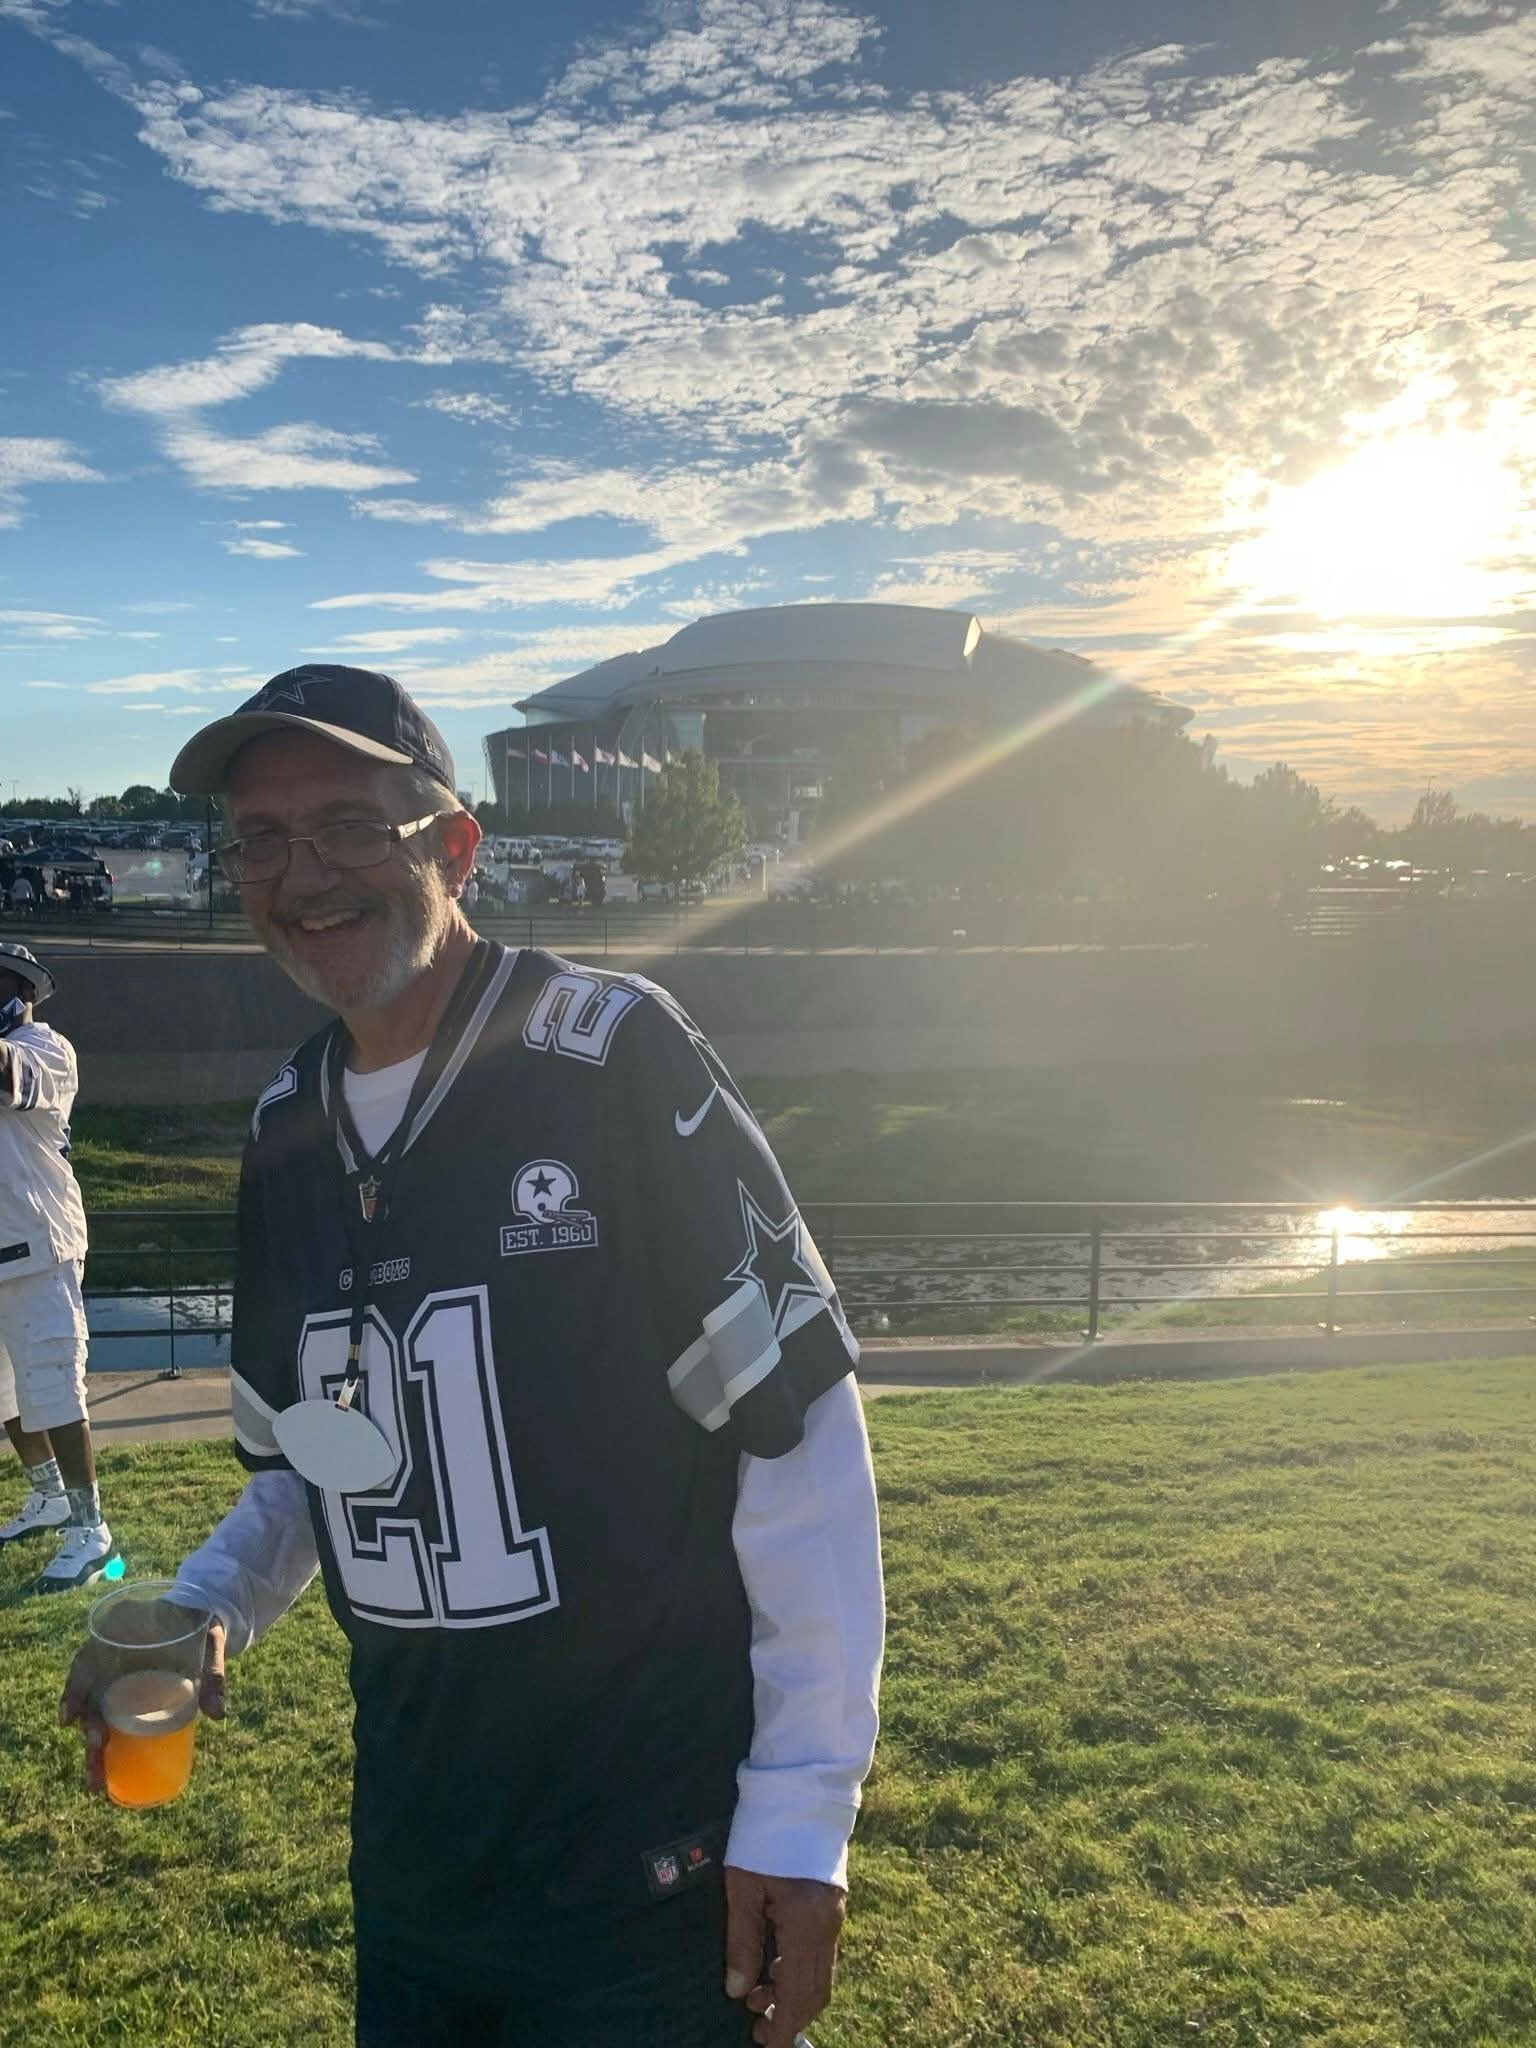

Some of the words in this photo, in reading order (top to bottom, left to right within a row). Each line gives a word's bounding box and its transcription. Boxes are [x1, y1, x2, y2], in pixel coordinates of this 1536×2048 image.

[505, 1228, 545, 1250] EST.
[551, 1223, 593, 1245] 1960
[338, 1256, 411, 1291] CBOYS
[297, 1283, 560, 1630] 21
